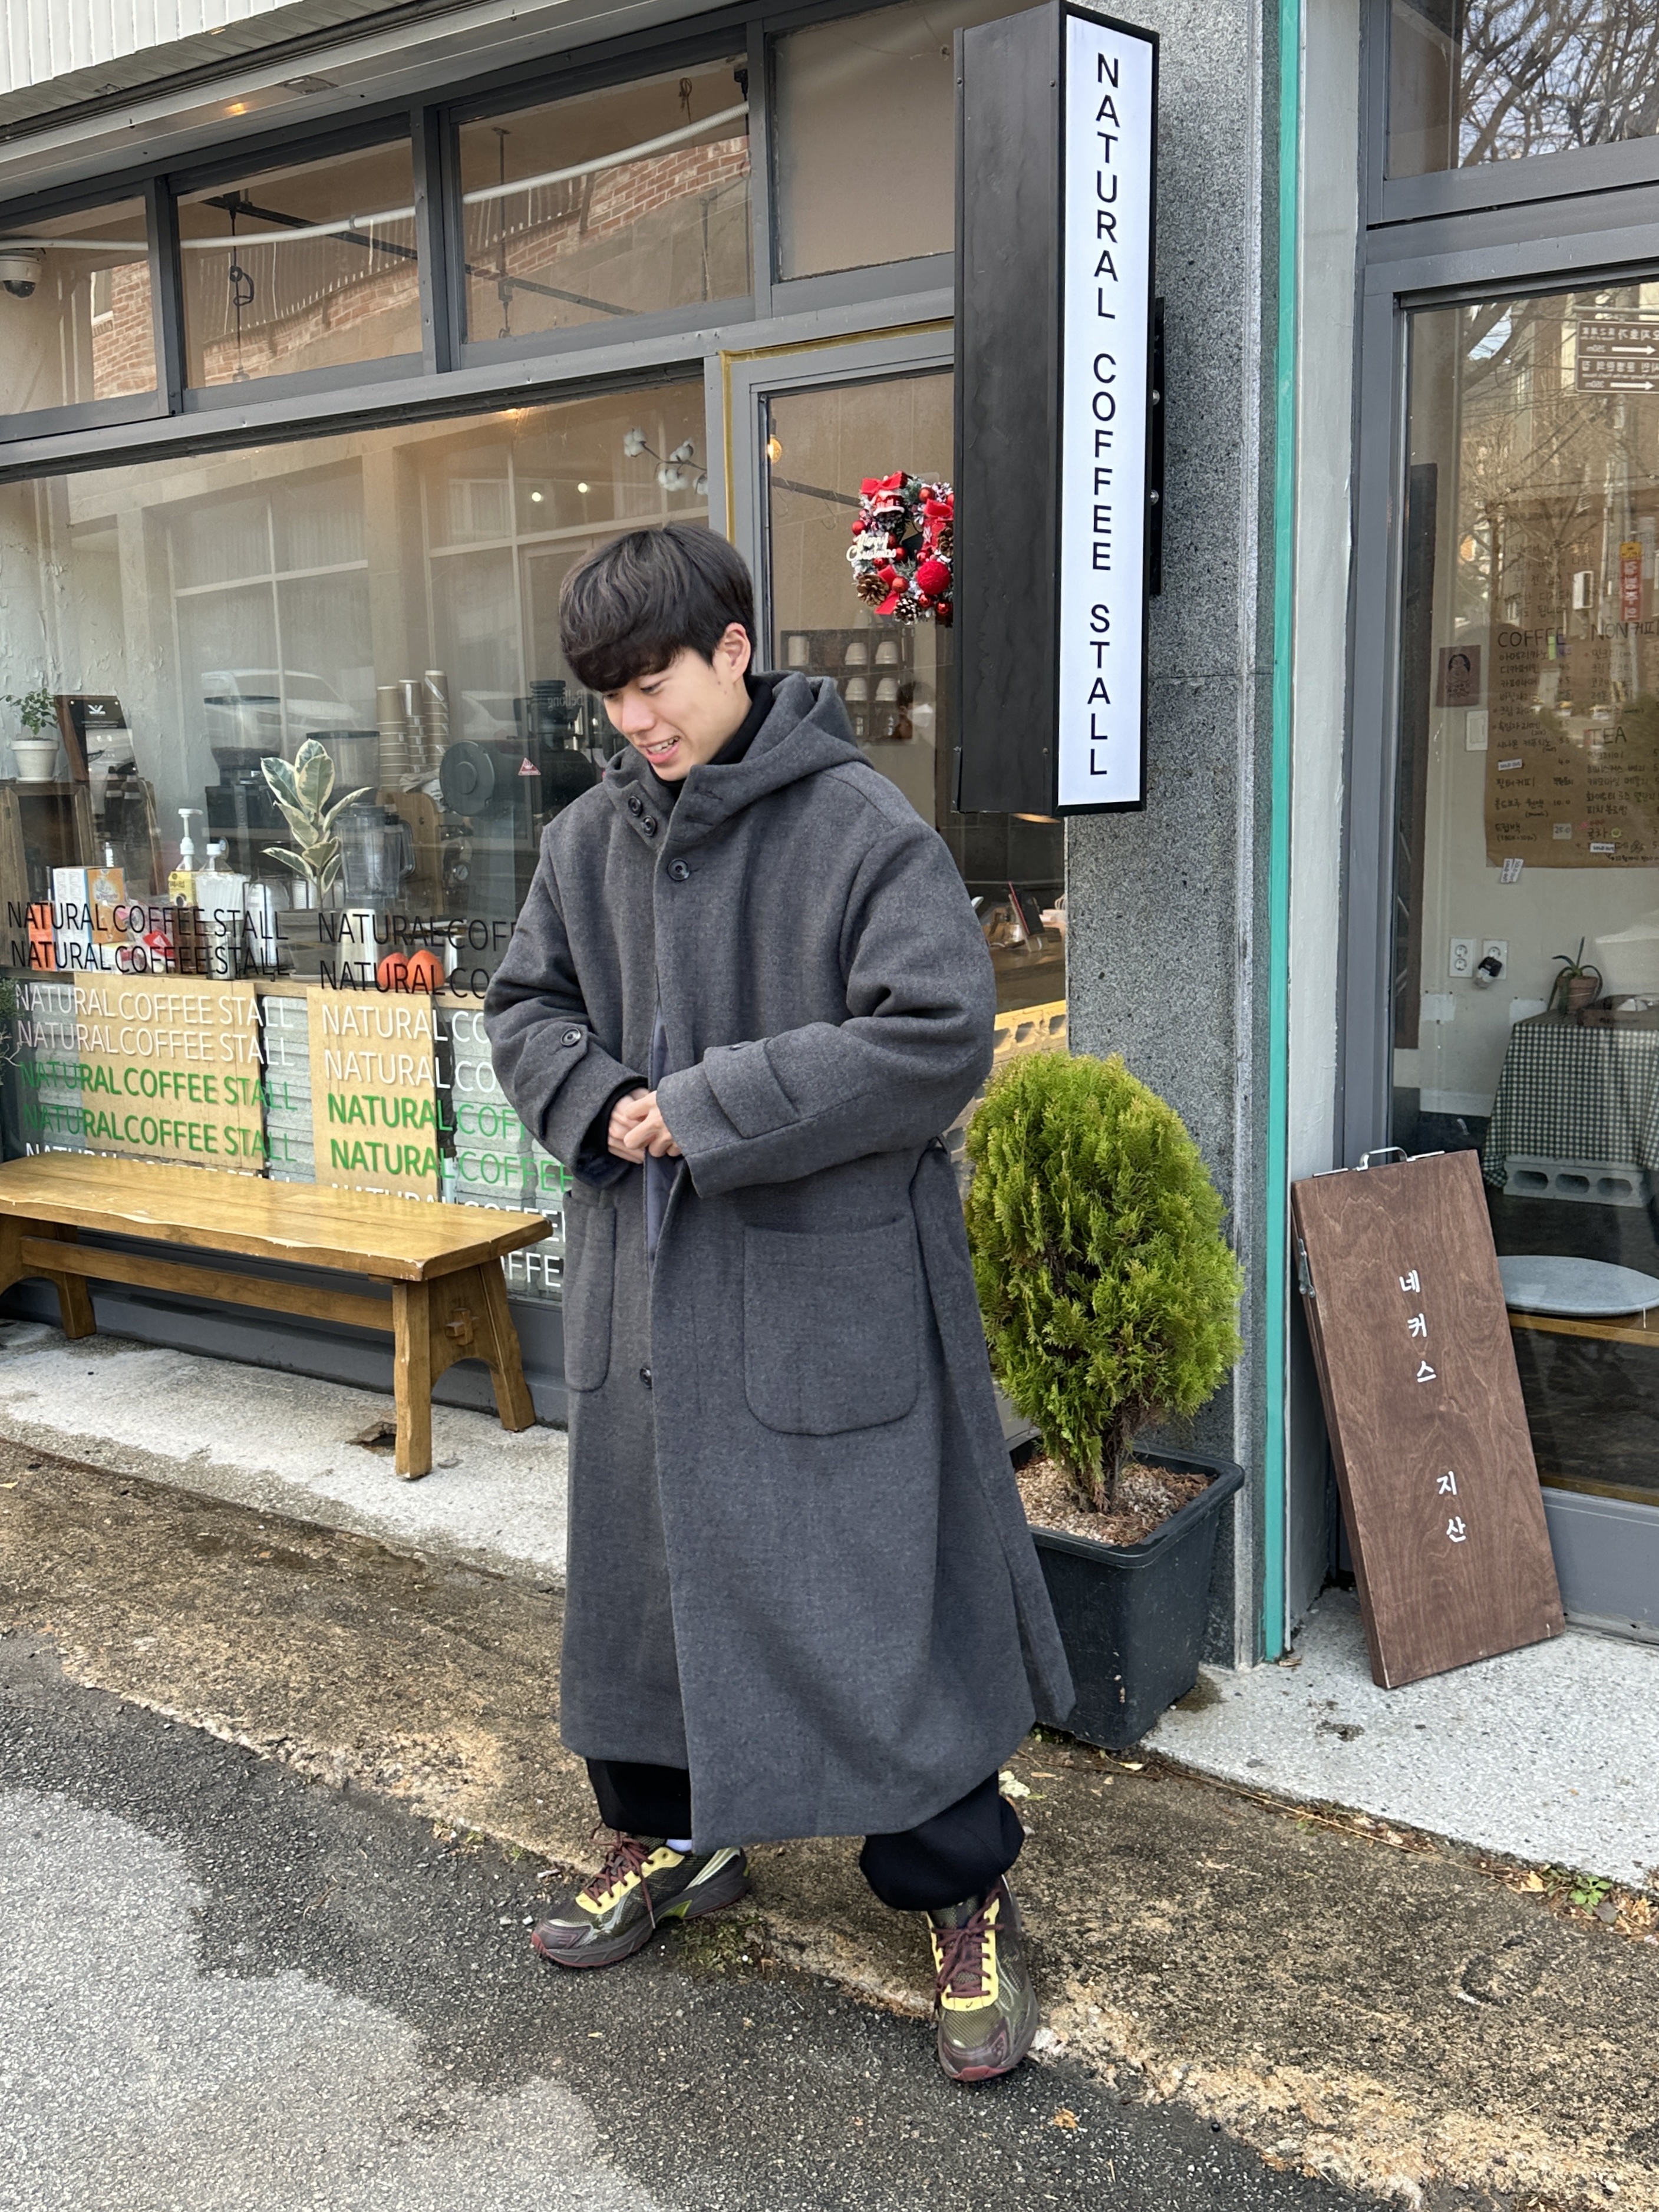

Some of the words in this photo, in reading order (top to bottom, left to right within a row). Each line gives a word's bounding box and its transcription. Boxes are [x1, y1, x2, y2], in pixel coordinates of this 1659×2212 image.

[1094, 52, 1120, 319] NATURAL
[1092, 353, 1116, 570] COFFEE
[853, 530, 889, 550] Merry
[1498, 627, 1566, 648] COFFEE
[1591, 622, 1629, 641] NON
[1087, 604, 1110, 775] STALL
[1587, 726, 1627, 745] TEA
[7, 901, 108, 932] NATURAL
[113, 904, 205, 936] COFFEE
[213, 908, 289, 940] STALL
[318, 912, 445, 947] NATURAL
[11, 940, 112, 970] NATURAL
[114, 945, 210, 975] COFFEE
[215, 946, 290, 976] STALL
[319, 960, 446, 996] NATURAL
[15, 983, 117, 1017] NATURAL
[118, 992, 213, 1025] COFFEE
[219, 996, 294, 1028] STALL
[322, 1004, 448, 1042] NATURAL
[18, 1020, 118, 1054] NATURAL
[120, 1026, 215, 1061] COFFEE
[219, 1032, 294, 1067] STALL
[19, 1061, 122, 1095] NATURAL
[123, 1067, 219, 1104] COFFEE
[223, 1075, 298, 1111] STALL
[324, 1049, 451, 1089] NATURAL
[23, 1102, 125, 1141] NATURAL
[124, 1114, 219, 1153] COFFEE
[223, 1125, 297, 1162] STALL
[328, 1093, 453, 1132] NATURAL
[330, 1138, 456, 1179] NATURAL
[1399, 1269, 1437, 1383] 네커스
[1436, 1471, 1467, 1543] 지산
